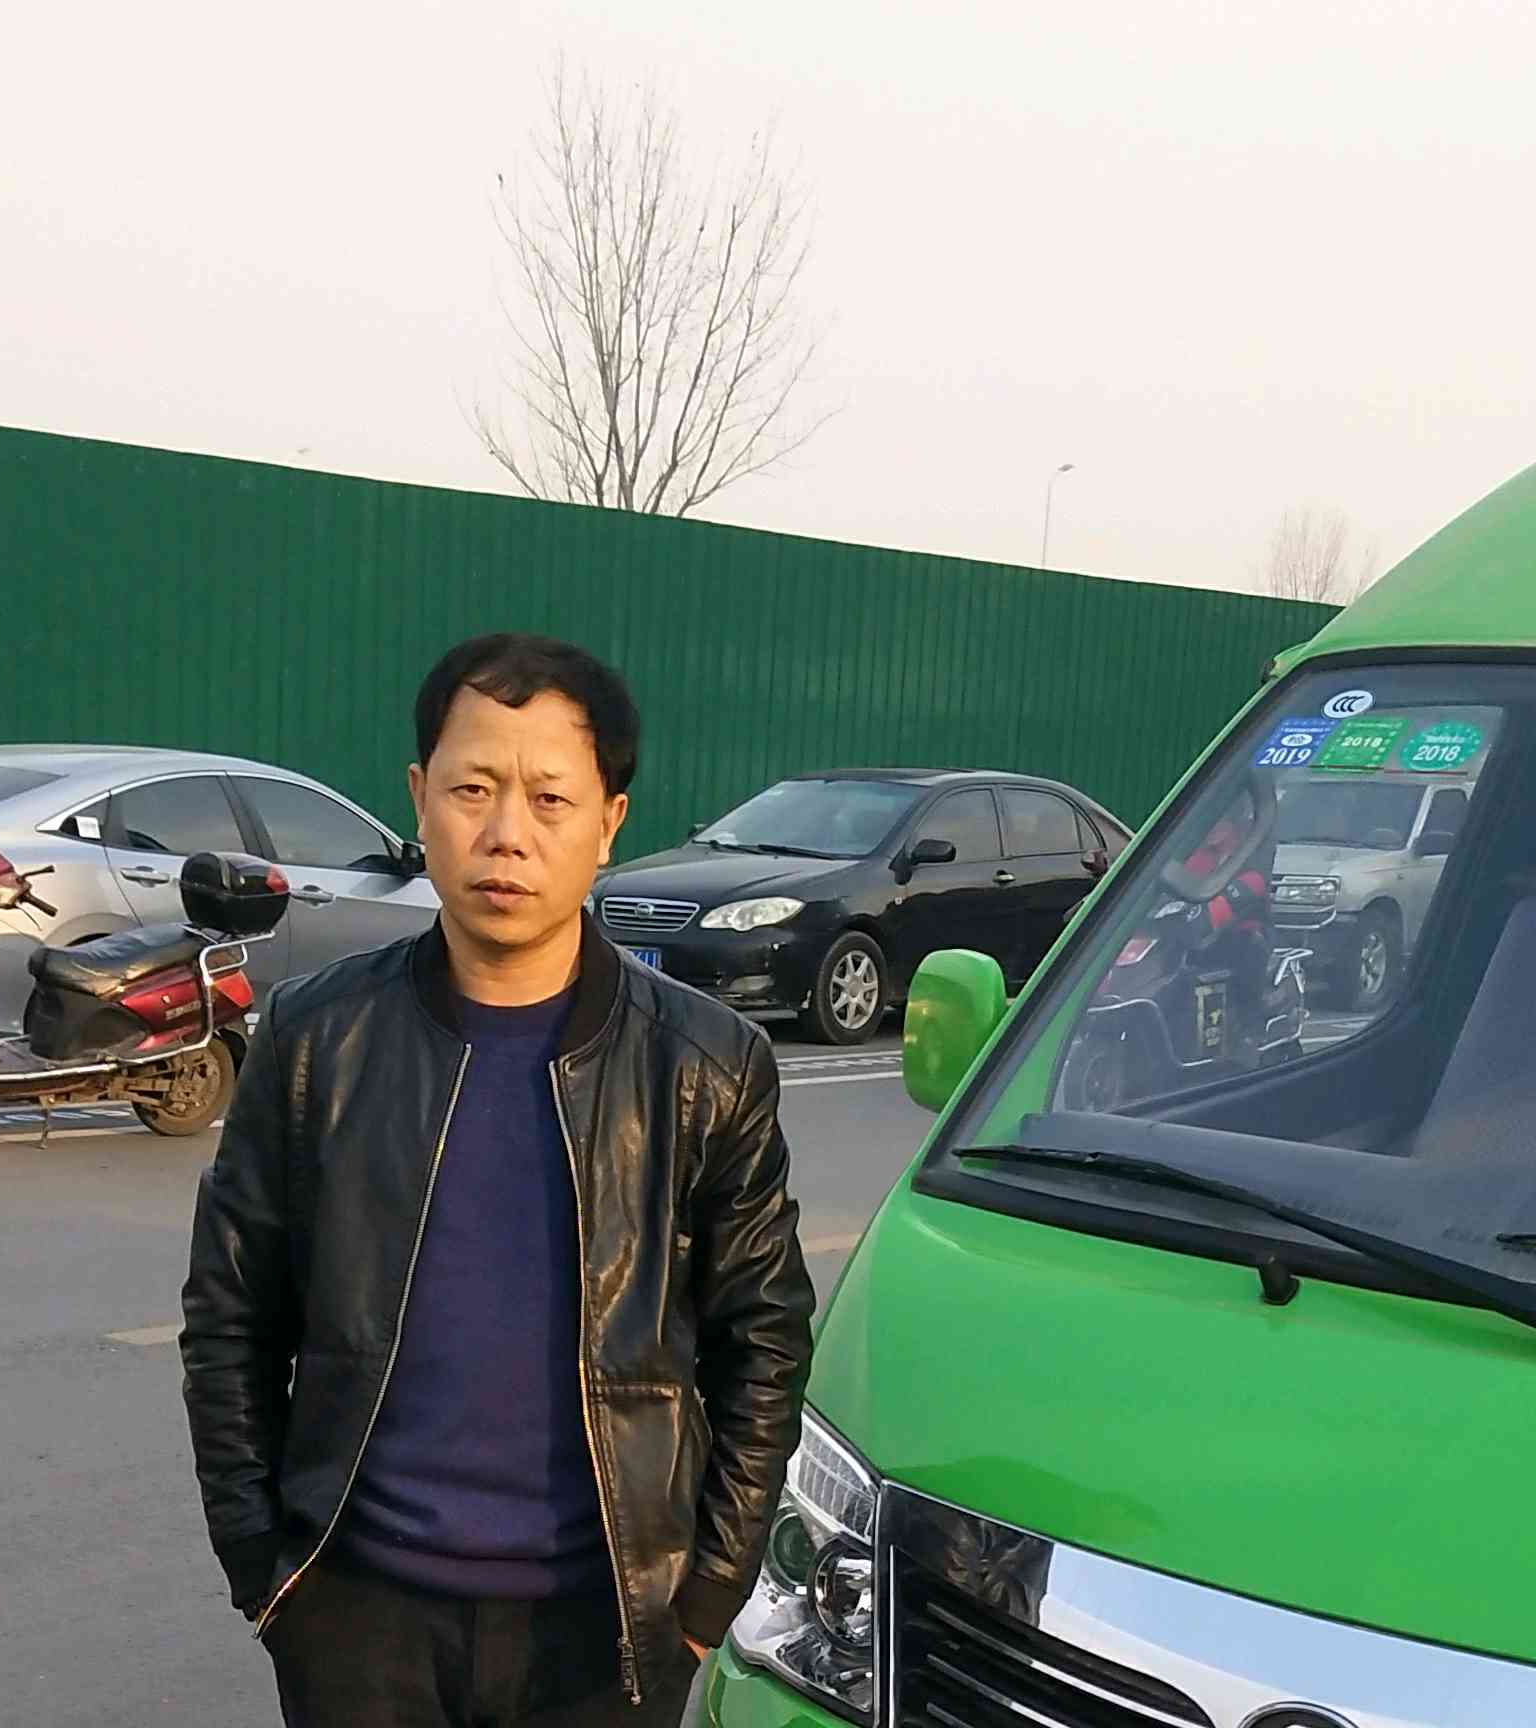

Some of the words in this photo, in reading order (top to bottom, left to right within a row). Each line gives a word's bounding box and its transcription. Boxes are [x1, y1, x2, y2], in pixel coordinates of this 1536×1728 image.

[1341, 736, 1383, 748] 2018
[1258, 748, 1312, 765] 2019
[1413, 745, 1461, 762] 2018
